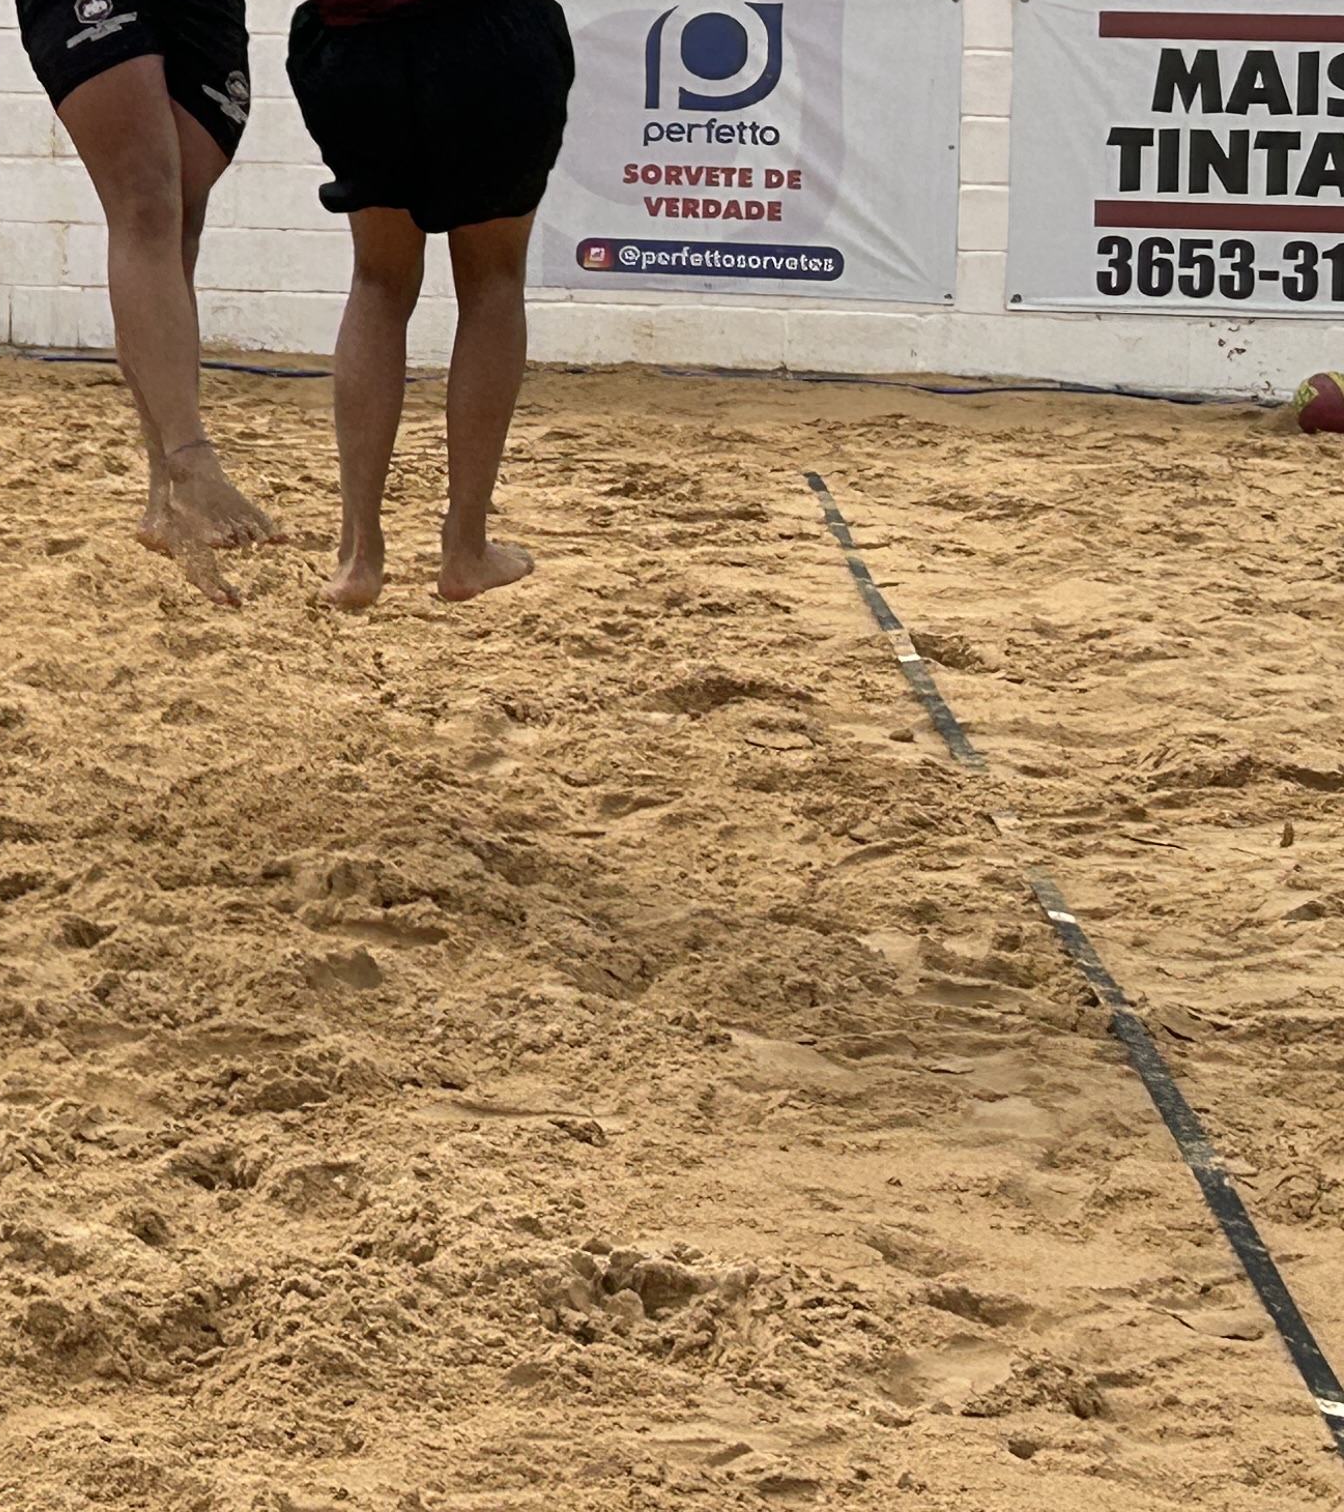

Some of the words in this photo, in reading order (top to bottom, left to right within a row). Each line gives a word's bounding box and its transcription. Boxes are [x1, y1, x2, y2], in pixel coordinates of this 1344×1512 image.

[642, 118, 781, 147] perfetto
[1106, 126, 1344, 198] TINTA
[622, 163, 753, 189] SORVETE
[764, 168, 803, 190] DE
[643, 196, 783, 222] VERDADE
